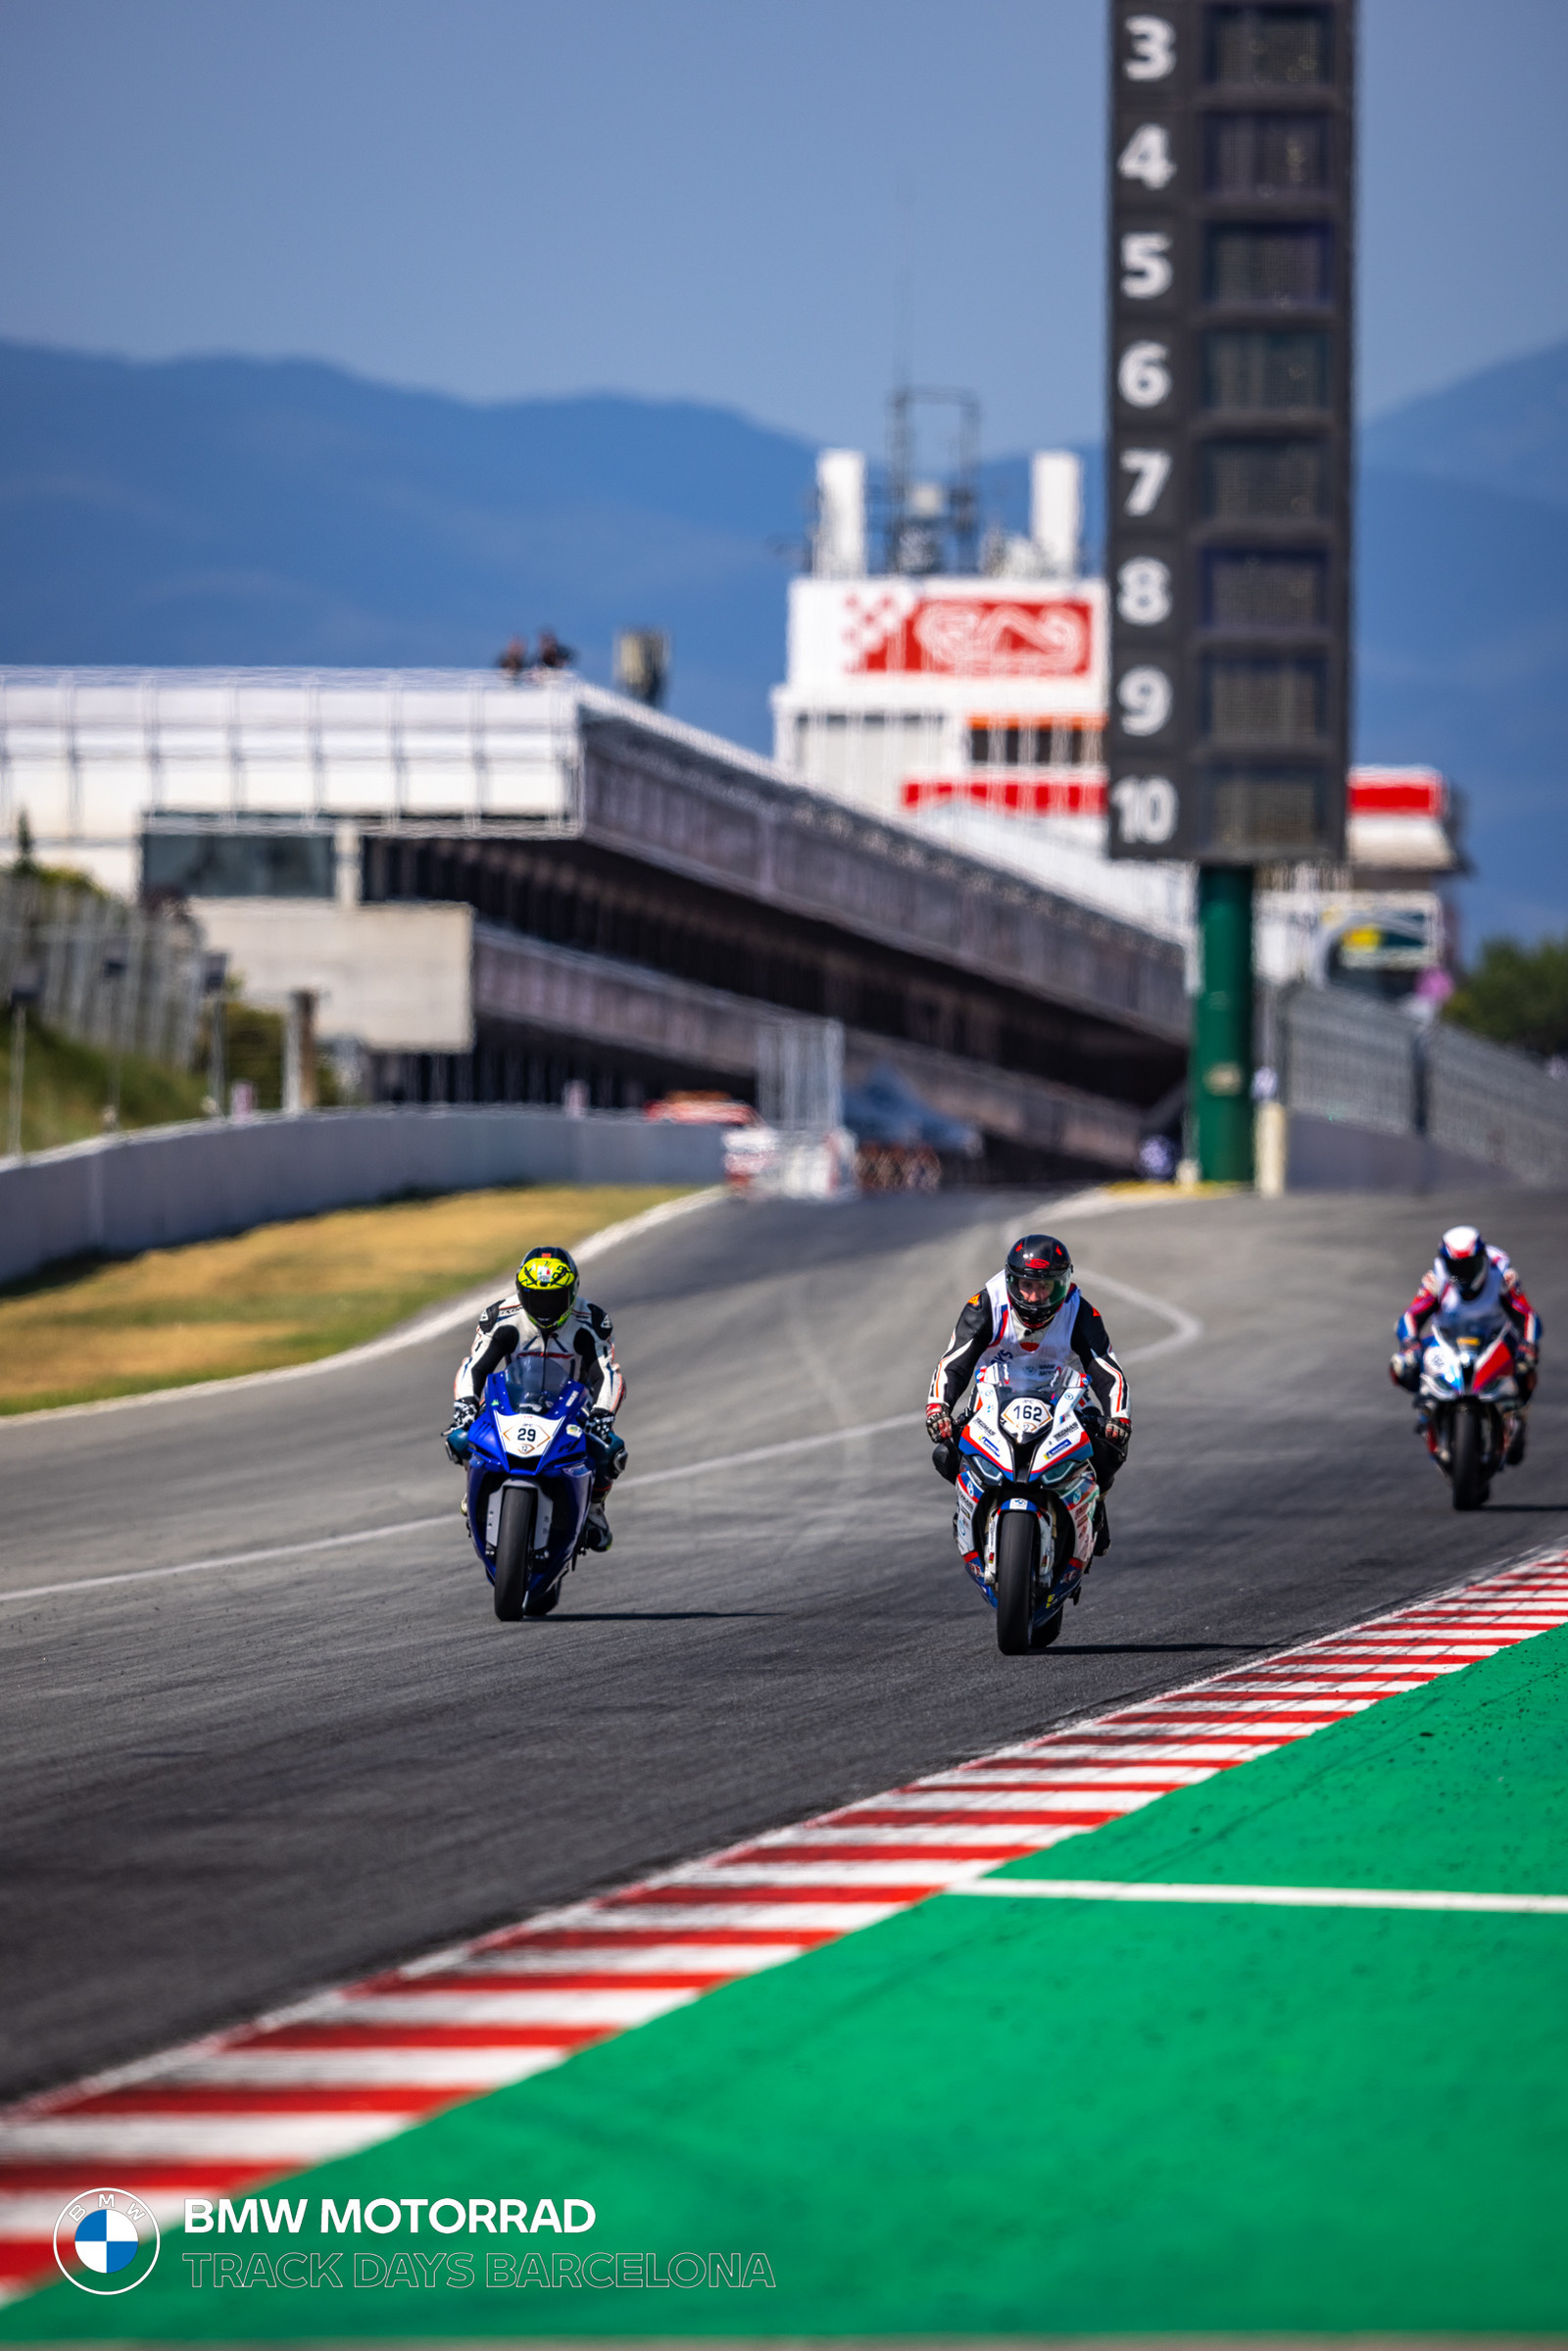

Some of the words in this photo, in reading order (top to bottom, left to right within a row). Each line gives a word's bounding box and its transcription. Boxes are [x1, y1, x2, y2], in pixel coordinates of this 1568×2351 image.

[1124, 15, 1175, 81] 3
[1118, 123, 1176, 189] 4
[1121, 232, 1172, 299] 5
[1118, 340, 1171, 408] 6
[1120, 448, 1172, 516] 7
[1117, 556, 1171, 625] 8
[1117, 665, 1172, 737] 9
[1112, 776, 1177, 845] 10
[516, 1427, 537, 1443] 29
[1013, 1404, 1043, 1423] 162
